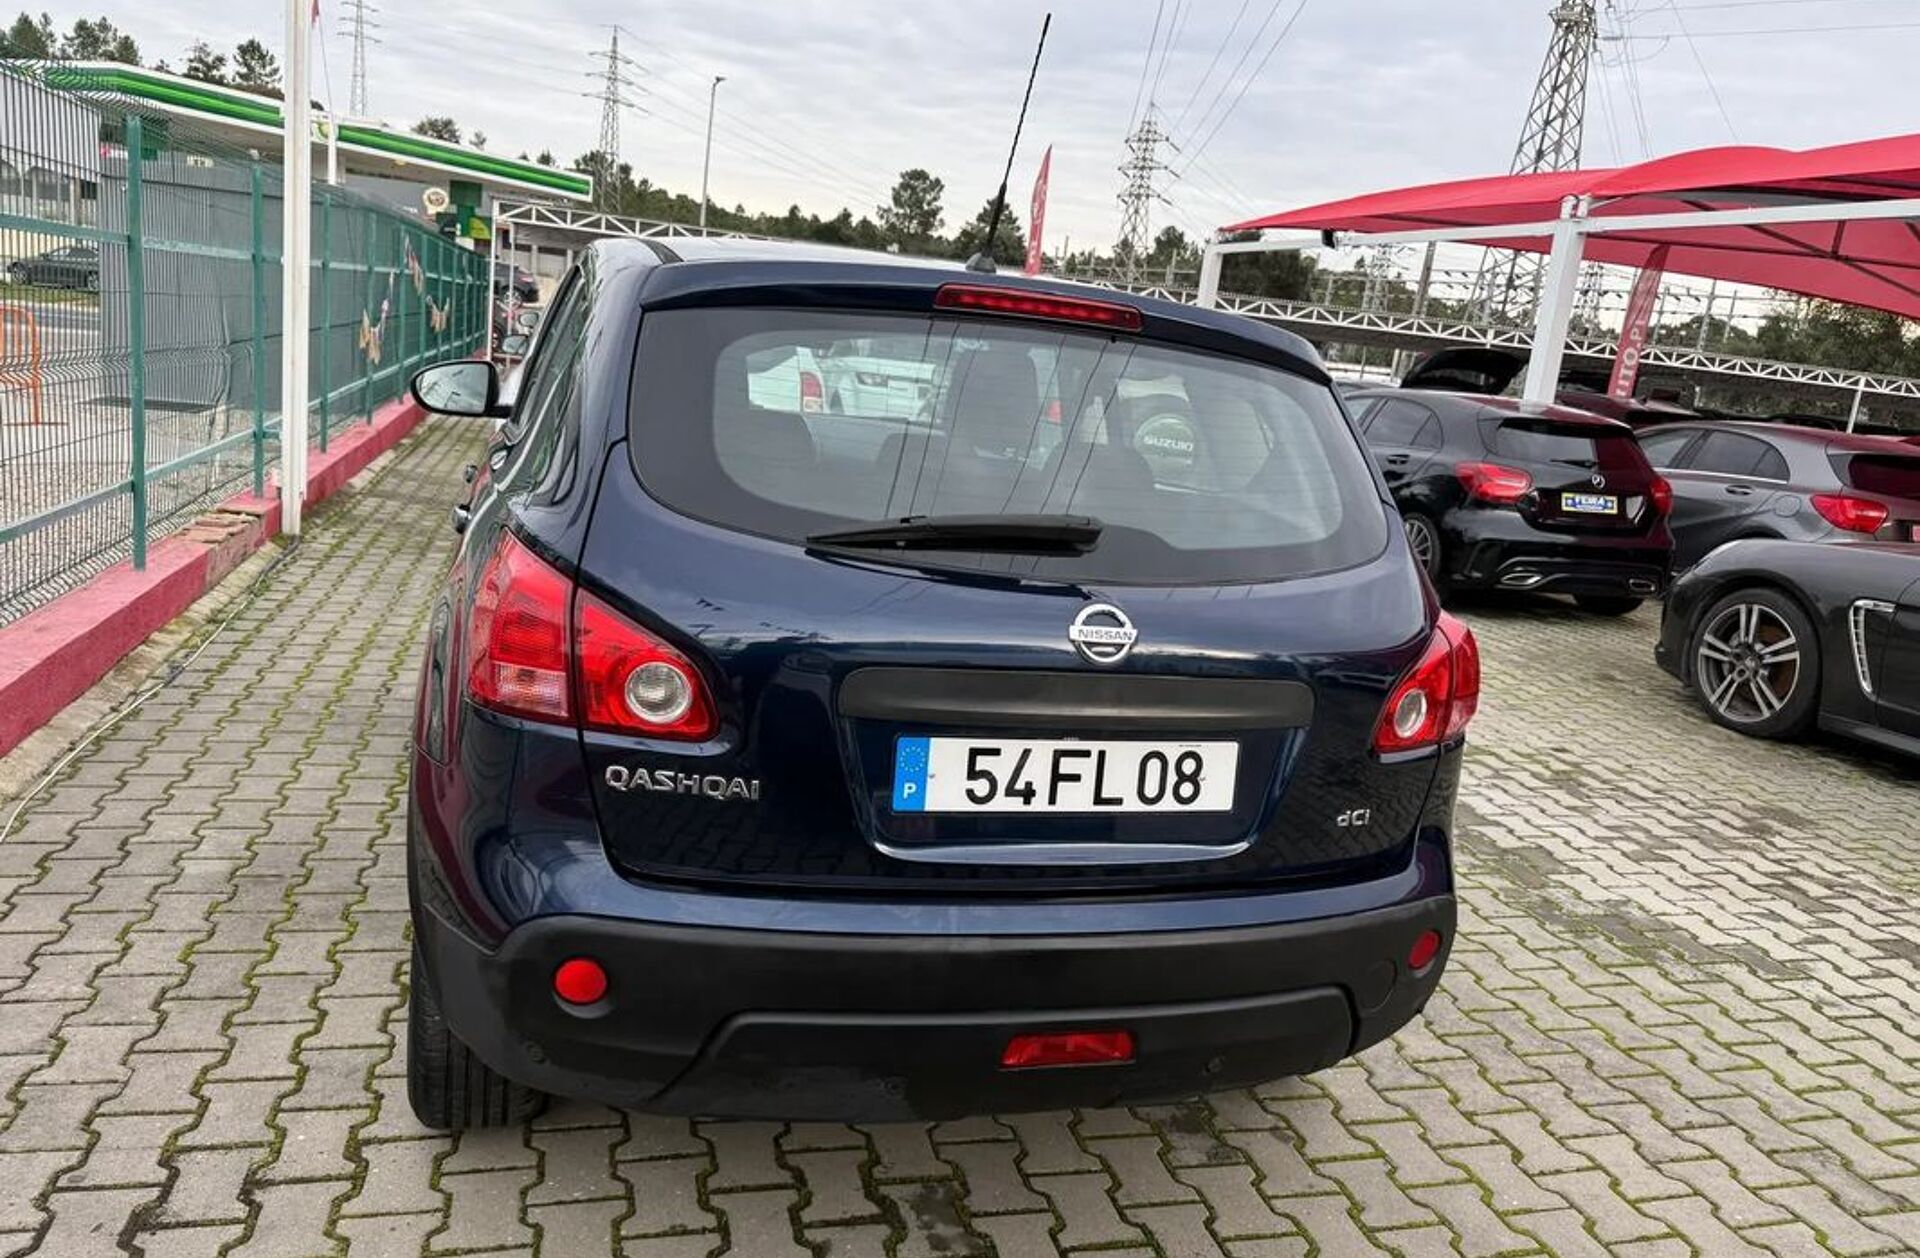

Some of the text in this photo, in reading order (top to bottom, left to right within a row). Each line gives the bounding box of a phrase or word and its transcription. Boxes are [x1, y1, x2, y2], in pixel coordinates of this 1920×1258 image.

[1077, 629, 1134, 641] NISSAN
[605, 765, 760, 801] QASHQAI
[903, 782, 917, 799] P
